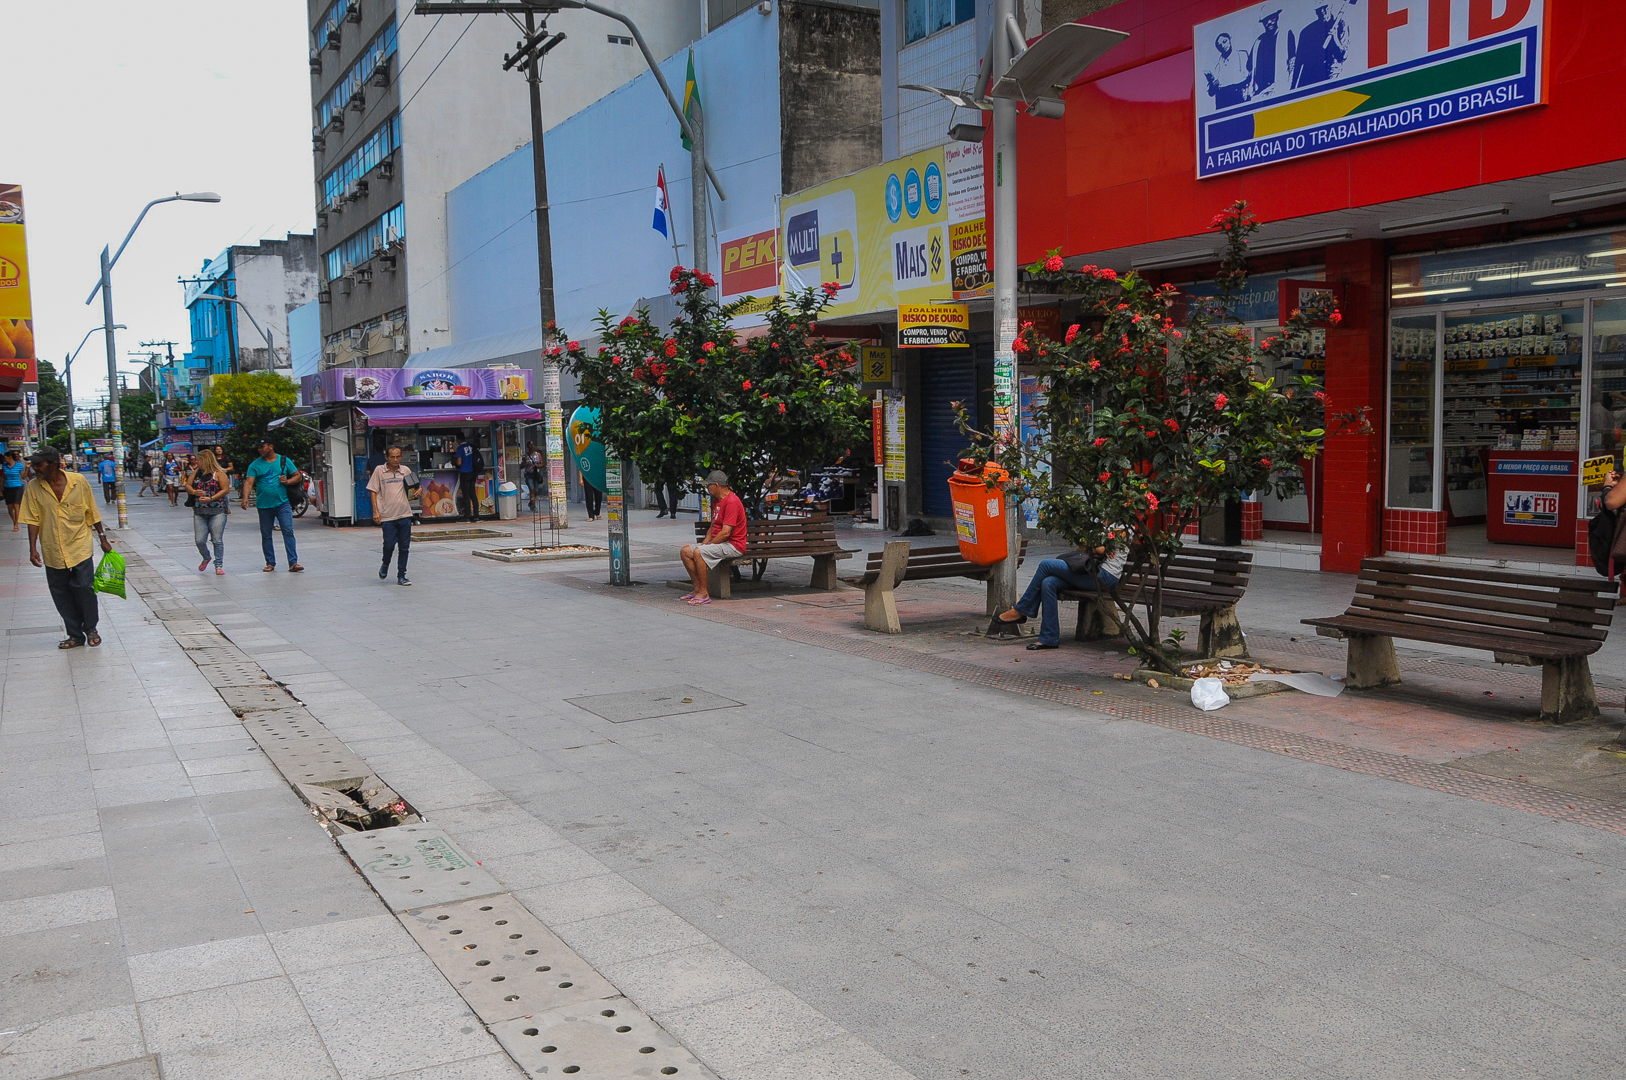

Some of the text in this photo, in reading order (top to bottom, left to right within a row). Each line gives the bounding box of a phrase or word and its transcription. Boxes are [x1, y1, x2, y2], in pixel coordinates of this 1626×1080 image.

[1206, 83, 1524, 169] A FARMÁCIA DO TRABALHADOR DO BRASIL
[952, 237, 972, 252] RISKO
[973, 235, 982, 249] DE
[955, 252, 980, 267] COMPRO,
[957, 267, 961, 277] E
[1263, 290, 1276, 302] DO
[903, 313, 964, 324] RISKO DE OURO
[903, 328, 948, 338] COMPRO, VENDO
[904, 336, 949, 345] E FABRICAMOS
[420, 372, 454, 380] SABOR
[1522, 464, 1540, 472] PREÇO
[1583, 457, 1613, 468] CAPA
[1534, 497, 1557, 513] FTB
